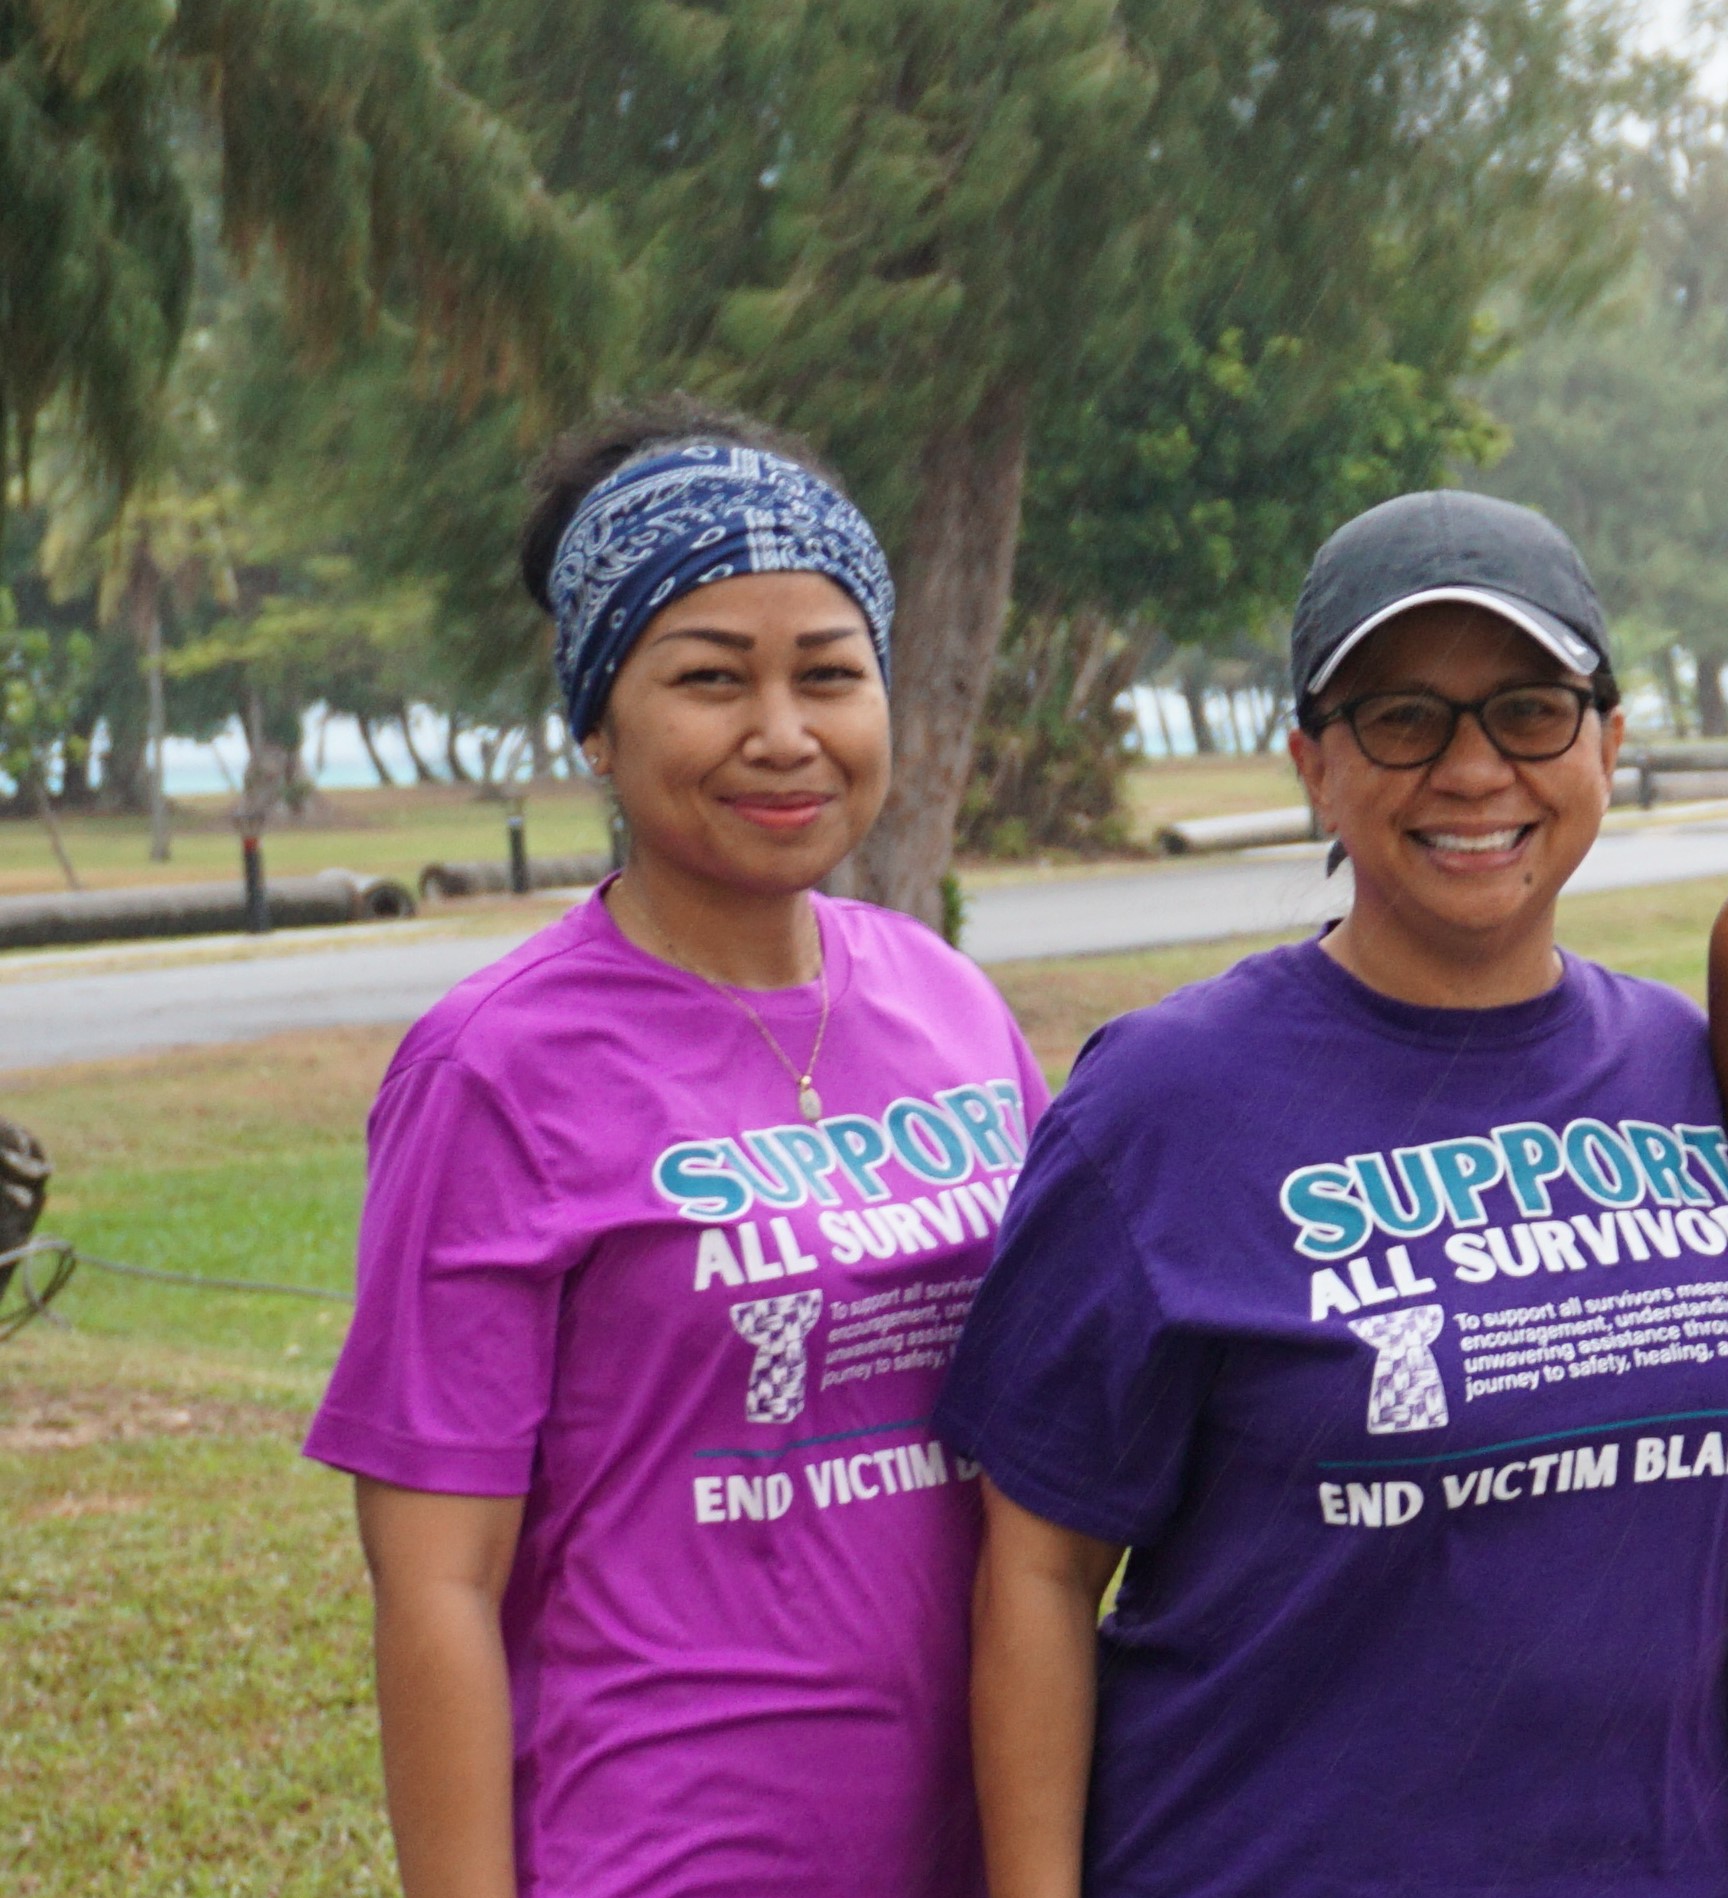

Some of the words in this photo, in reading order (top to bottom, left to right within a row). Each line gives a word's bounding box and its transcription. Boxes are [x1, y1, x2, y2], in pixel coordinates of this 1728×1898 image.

[652, 1079, 1028, 1222] SUPPORT
[694, 1216, 818, 1291] ALL
[1311, 1245, 1436, 1322] ALL
[850, 1288, 900, 1316] support
[1453, 1312, 1480, 1331] To
[1482, 1302, 1557, 1327] support
[1559, 1296, 1583, 1317] all
[1584, 1289, 1675, 1314] survivors
[1460, 1315, 1613, 1351] encouragement,
[1463, 1343, 1576, 1374] unwavering
[1577, 1331, 1681, 1355] assistance
[1464, 1370, 1540, 1403] journey
[1542, 1364, 1565, 1383] to
[1567, 1353, 1632, 1379] safety,
[1633, 1342, 1714, 1368] healing,
[693, 1472, 794, 1523] END
[805, 1441, 948, 1509] VICTIM
[1319, 1481, 1424, 1528] END
[1442, 1445, 1619, 1510] VICTIM
